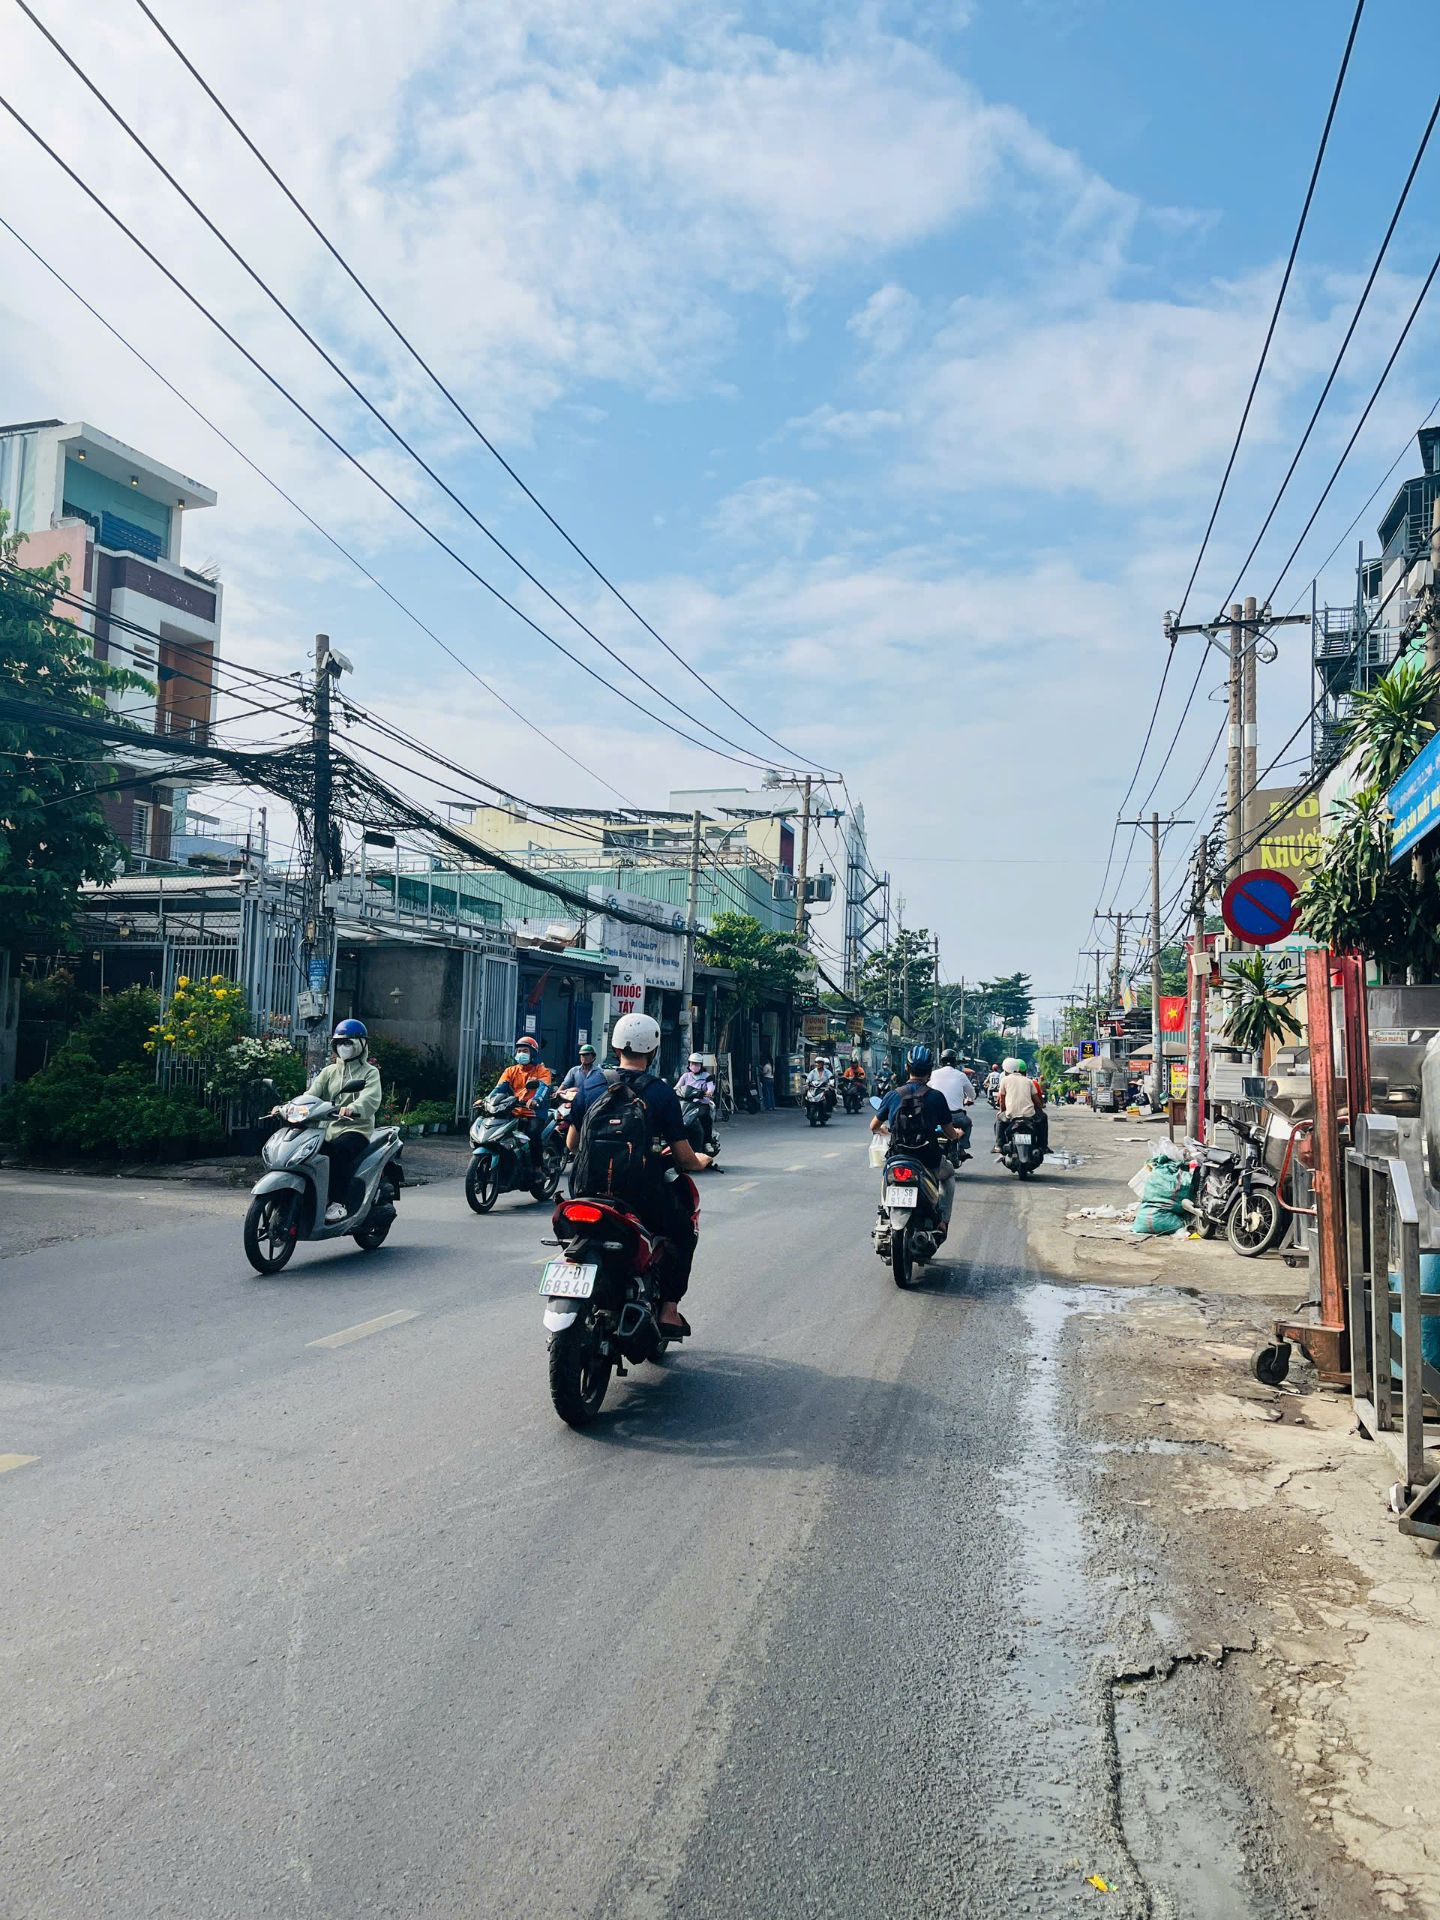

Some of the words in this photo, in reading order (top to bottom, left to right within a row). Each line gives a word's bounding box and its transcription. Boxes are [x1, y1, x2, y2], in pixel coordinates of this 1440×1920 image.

[612, 983, 642, 998] THUỐC
[618, 998, 635, 1014] TÂY
[552, 1264, 588, 1281] 77-D1
[543, 1279, 591, 1296] 683.40
